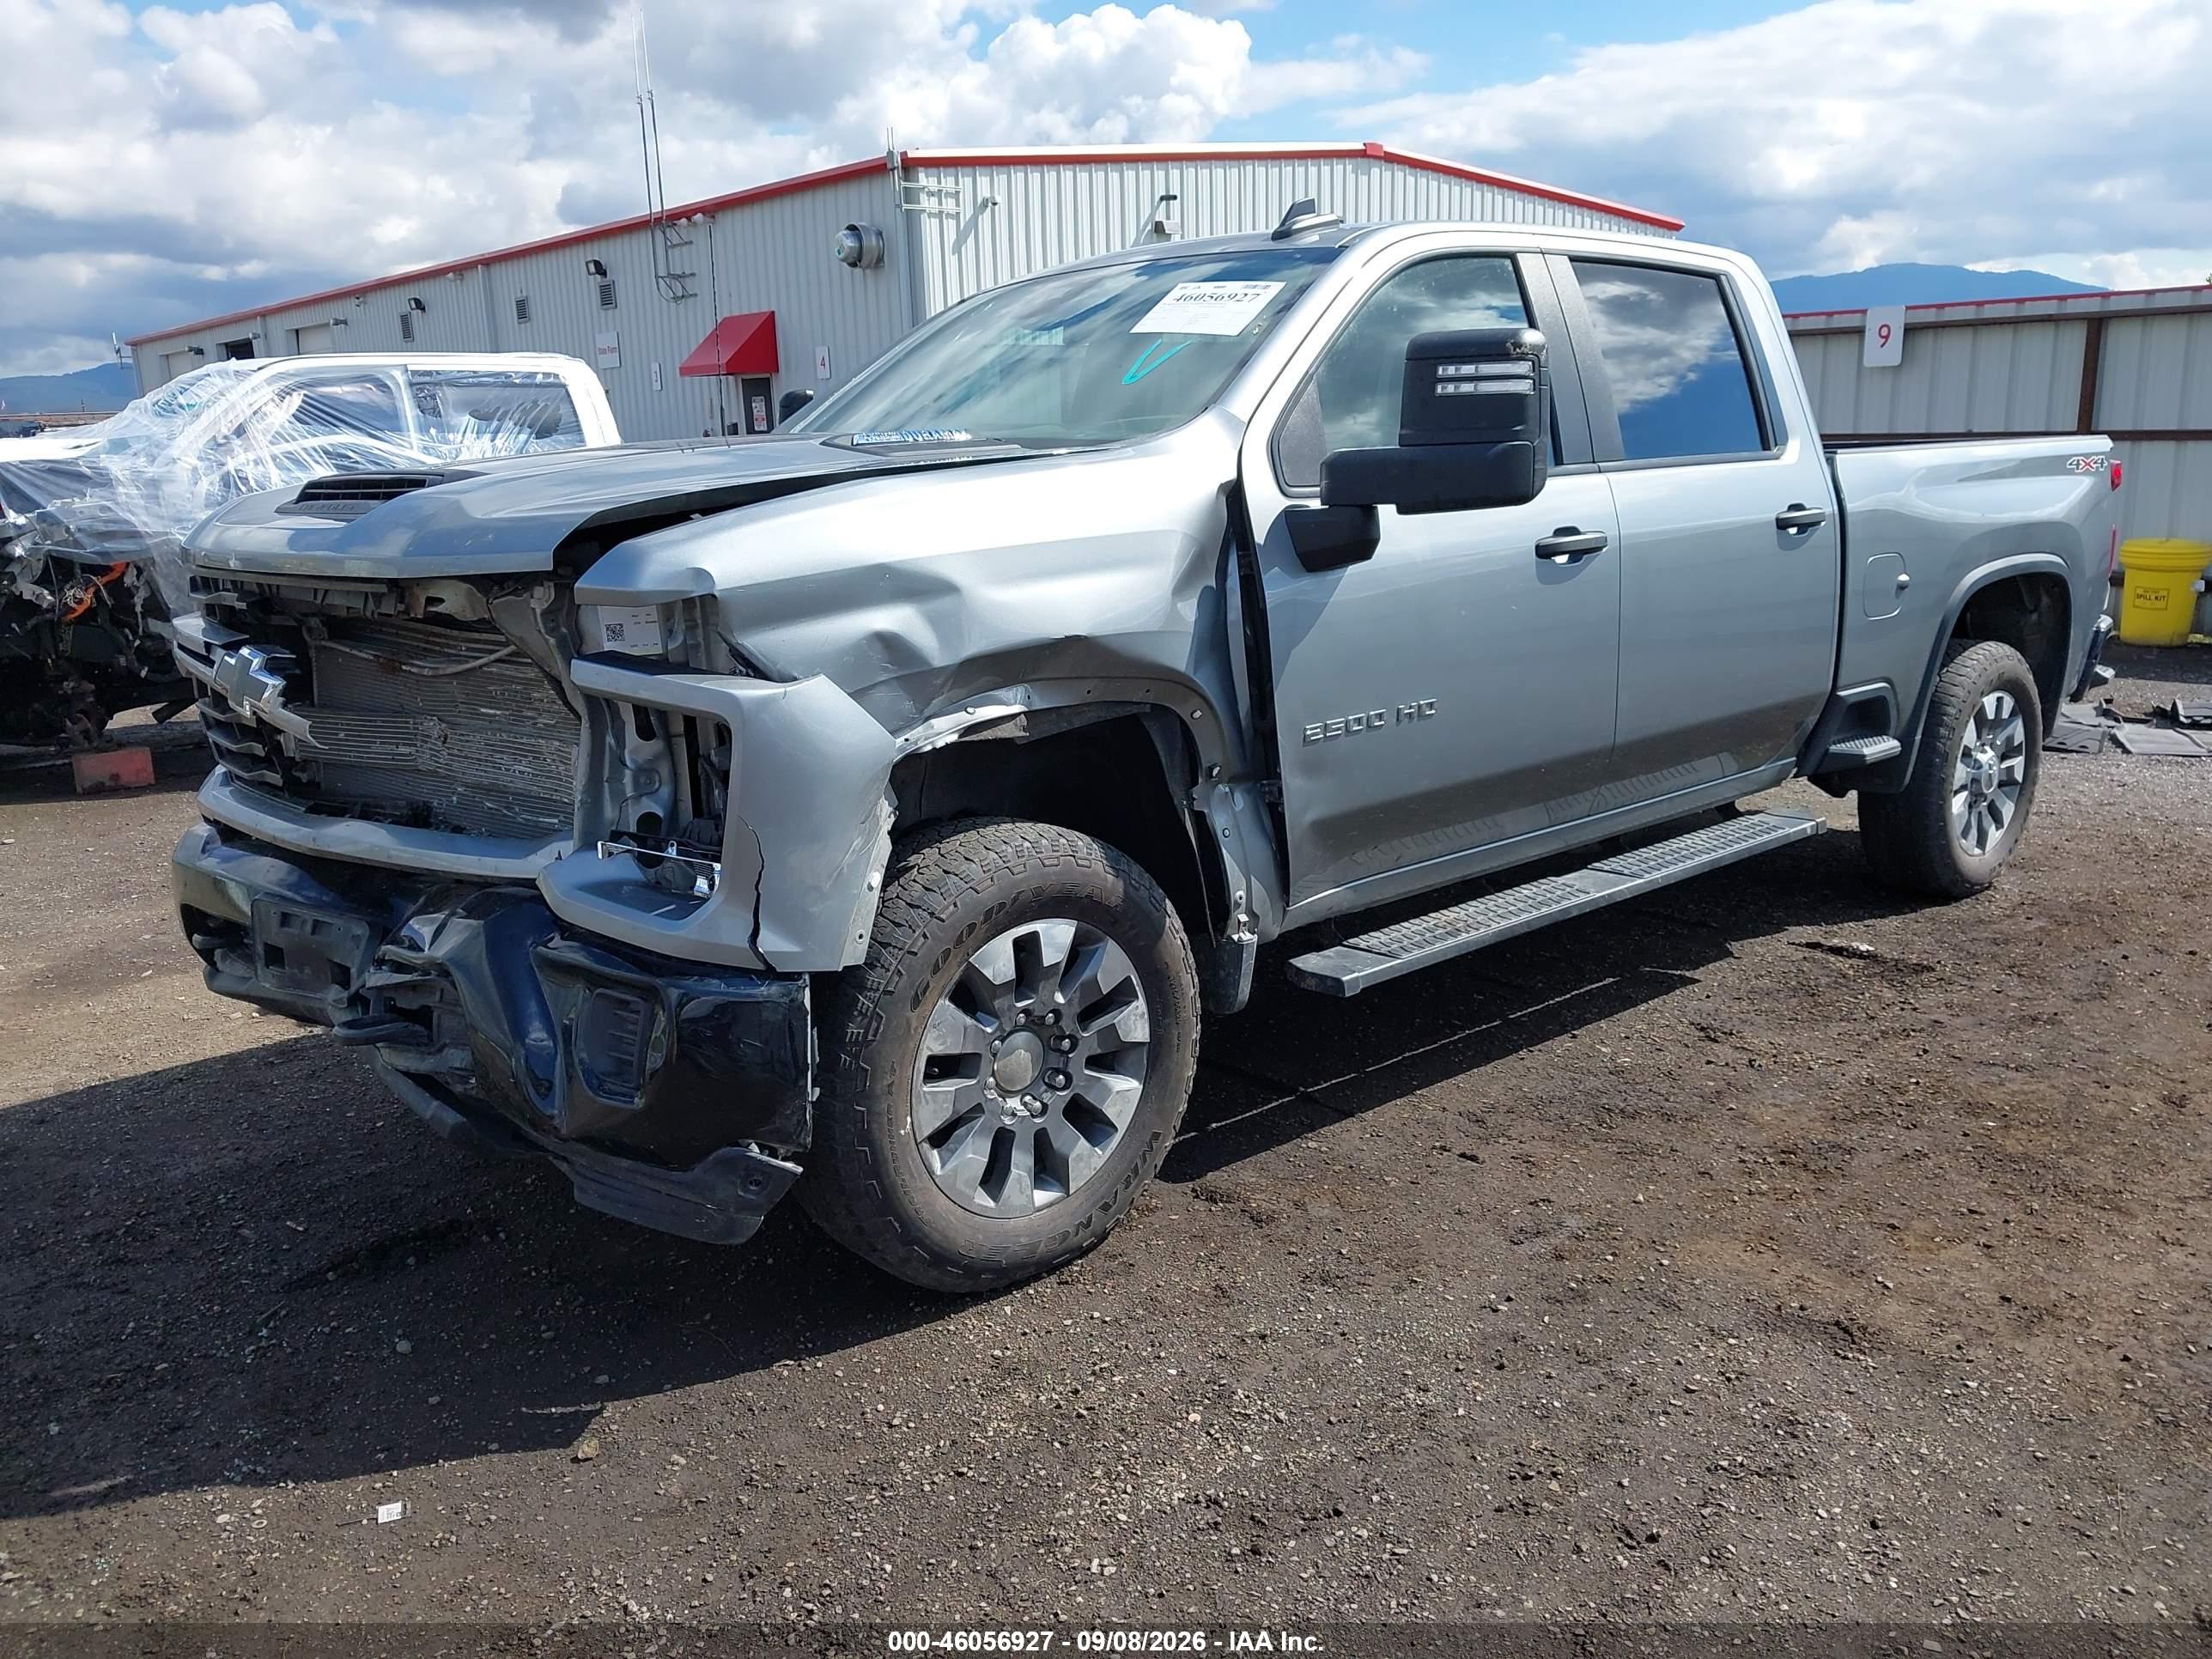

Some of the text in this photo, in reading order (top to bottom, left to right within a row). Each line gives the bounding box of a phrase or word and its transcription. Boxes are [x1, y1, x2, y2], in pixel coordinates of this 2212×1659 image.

[1172, 292, 1261, 303] 46056927
[1877, 324, 1892, 349] 9
[820, 355, 826, 370] 4
[2136, 592, 2151, 601] SPILL
[1303, 698, 1439, 744] 2500 HD
[909, 882, 1123, 1013] GOODYEAR
[957, 1129, 1164, 1262] WRANGLER
